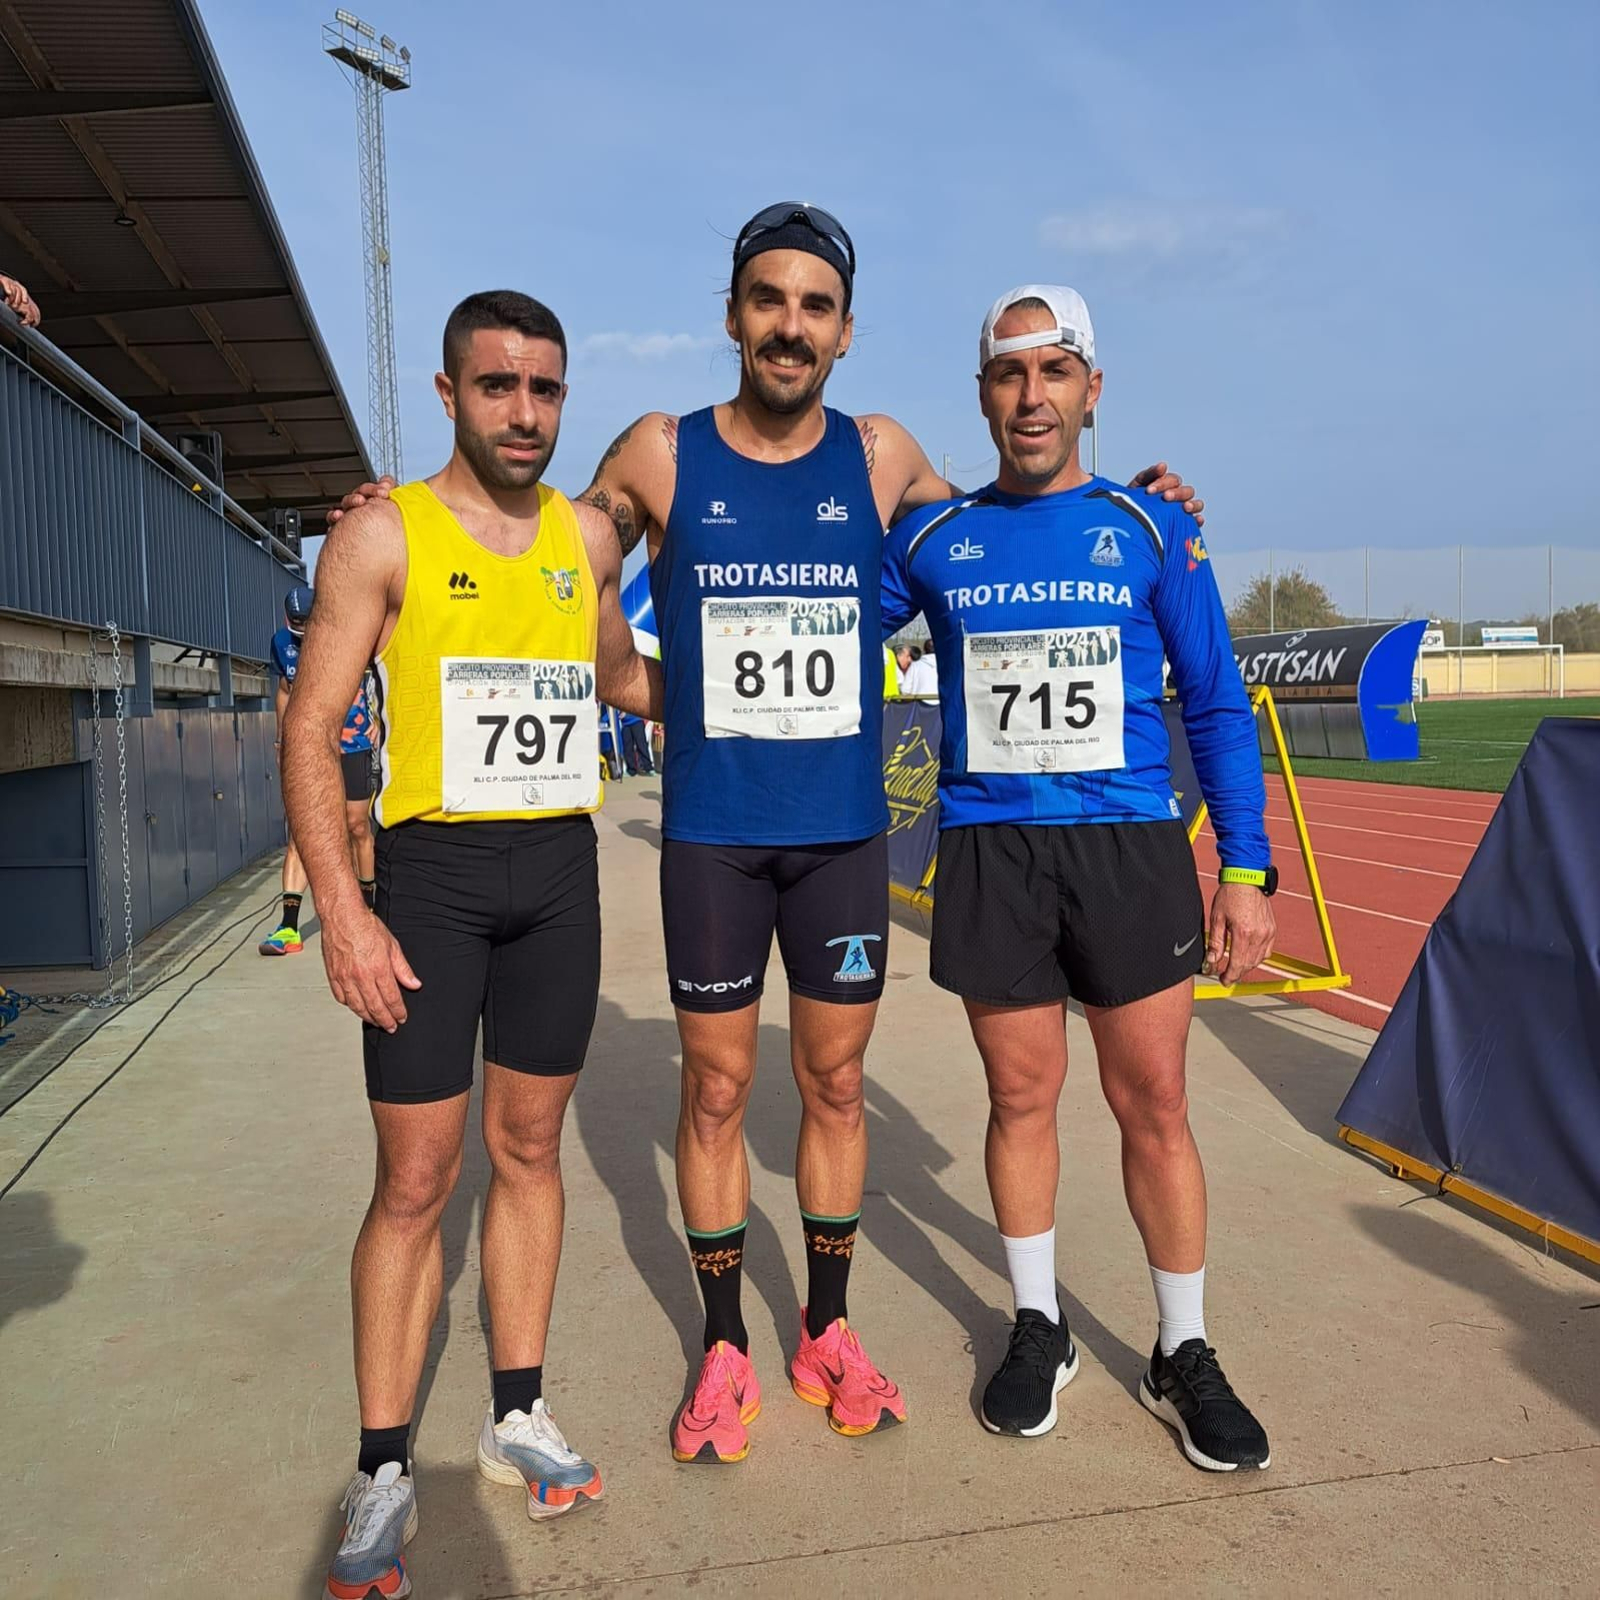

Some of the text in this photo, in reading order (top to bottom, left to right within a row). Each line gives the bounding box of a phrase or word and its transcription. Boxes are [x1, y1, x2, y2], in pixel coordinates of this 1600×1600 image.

[817, 496, 849, 521] als
[949, 537, 985, 561] als
[694, 563, 859, 588] TROTASIERRA
[450, 592, 480, 600] mobel
[944, 580, 1133, 610] TROTASIERRA
[790, 601, 829, 617] 2024
[1004, 643, 1046, 651] POPULARES
[1045, 633, 1089, 650] 2024
[1421, 635, 1441, 646] OP
[448, 671, 531, 680] CARRERAS POPULARES
[532, 664, 570, 681] 2024
[735, 649, 835, 699] 810
[1234, 648, 1348, 683] ASTYSAN
[991, 681, 1097, 731] 715
[477, 714, 577, 766] 797
